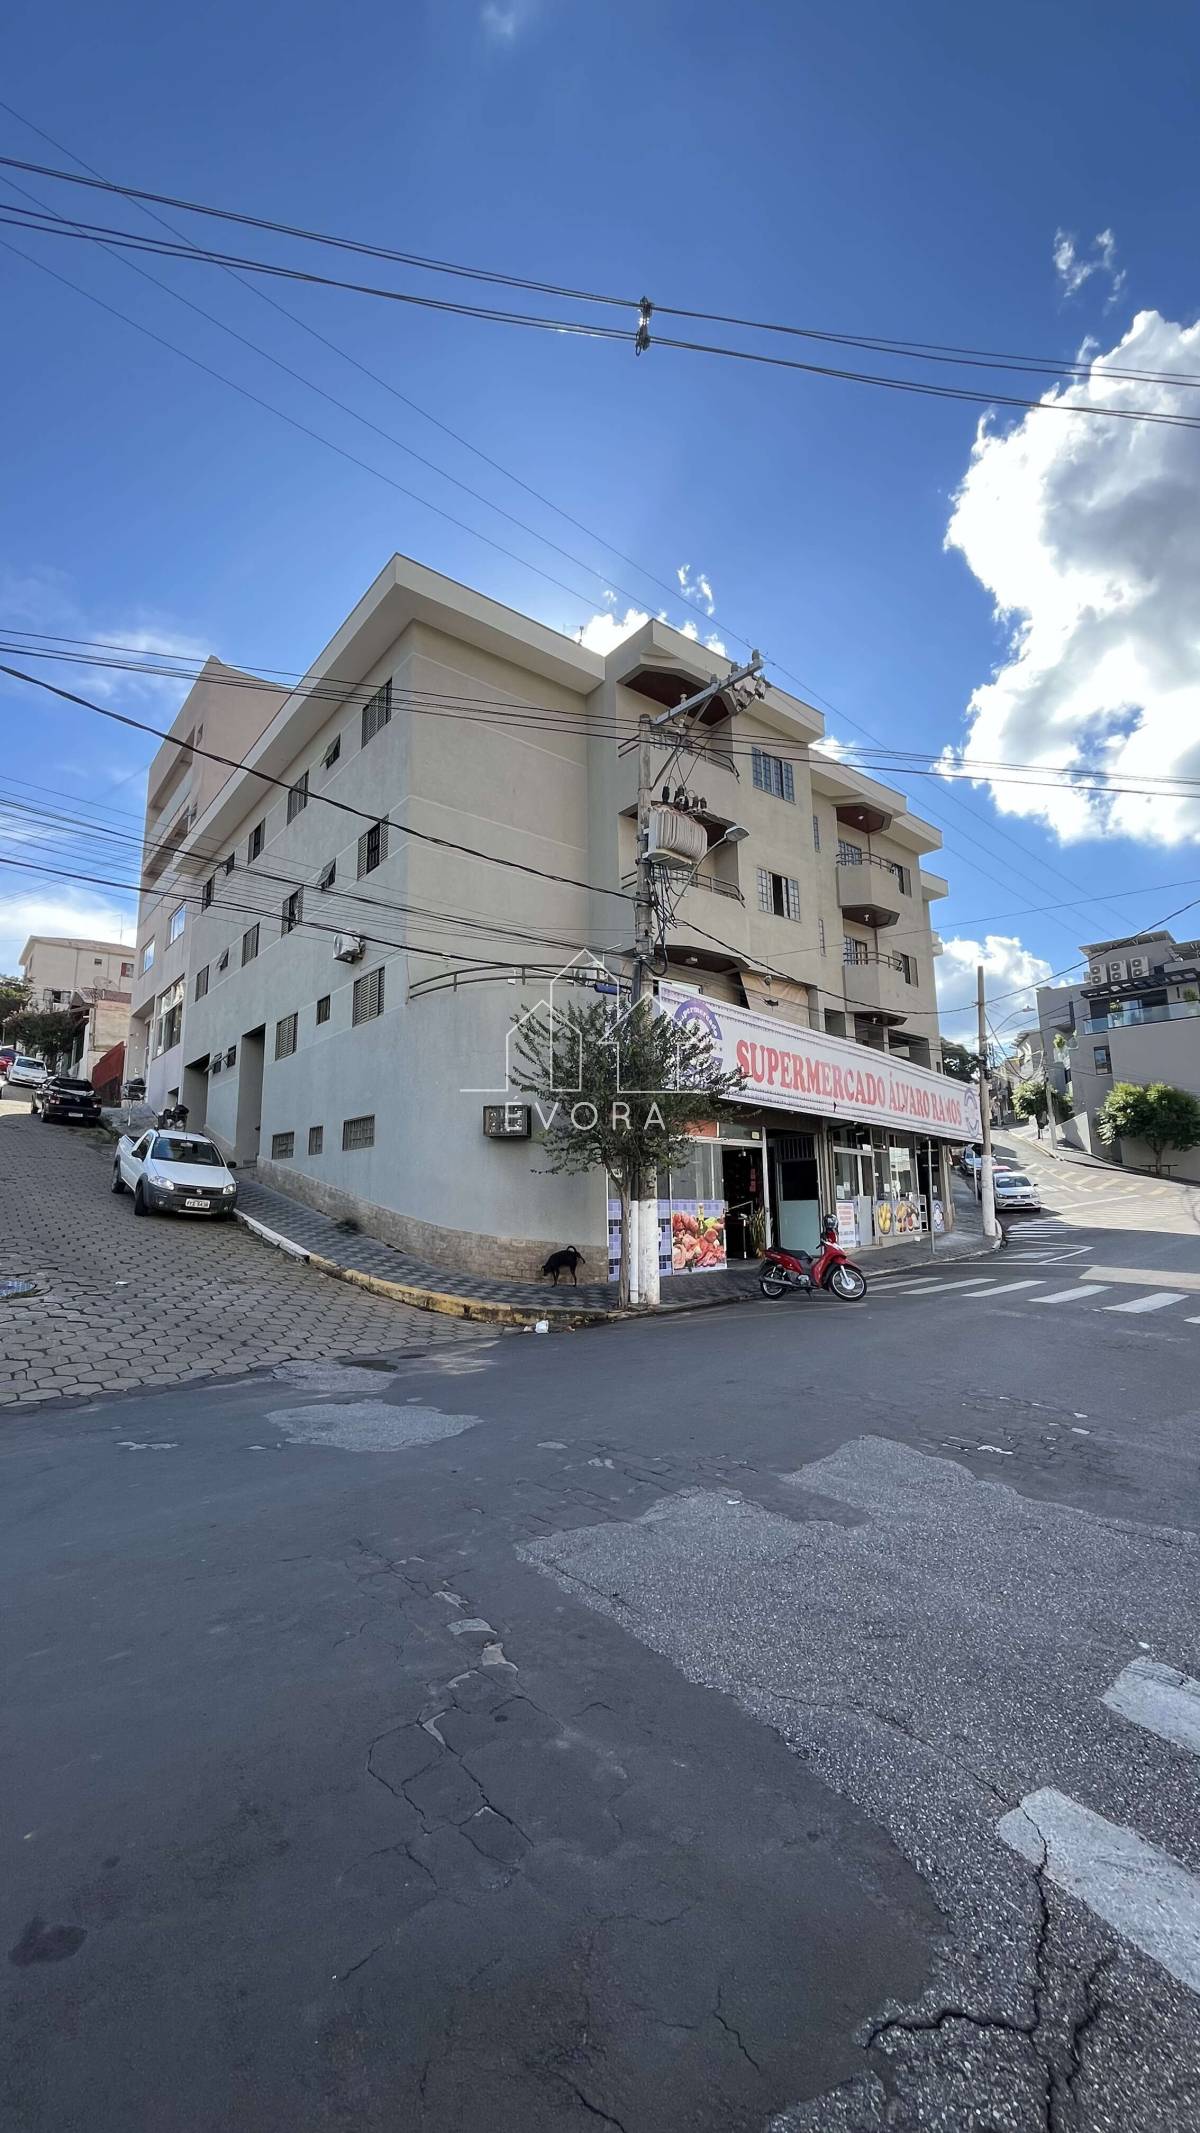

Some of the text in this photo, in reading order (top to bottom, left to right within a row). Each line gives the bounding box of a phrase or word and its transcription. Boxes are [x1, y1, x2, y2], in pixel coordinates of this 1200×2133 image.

[736, 1039, 885, 1107] SUPERMERCADO
[889, 1071, 930, 1117] ÁLVARO
[931, 1093, 962, 1126] RAMOS
